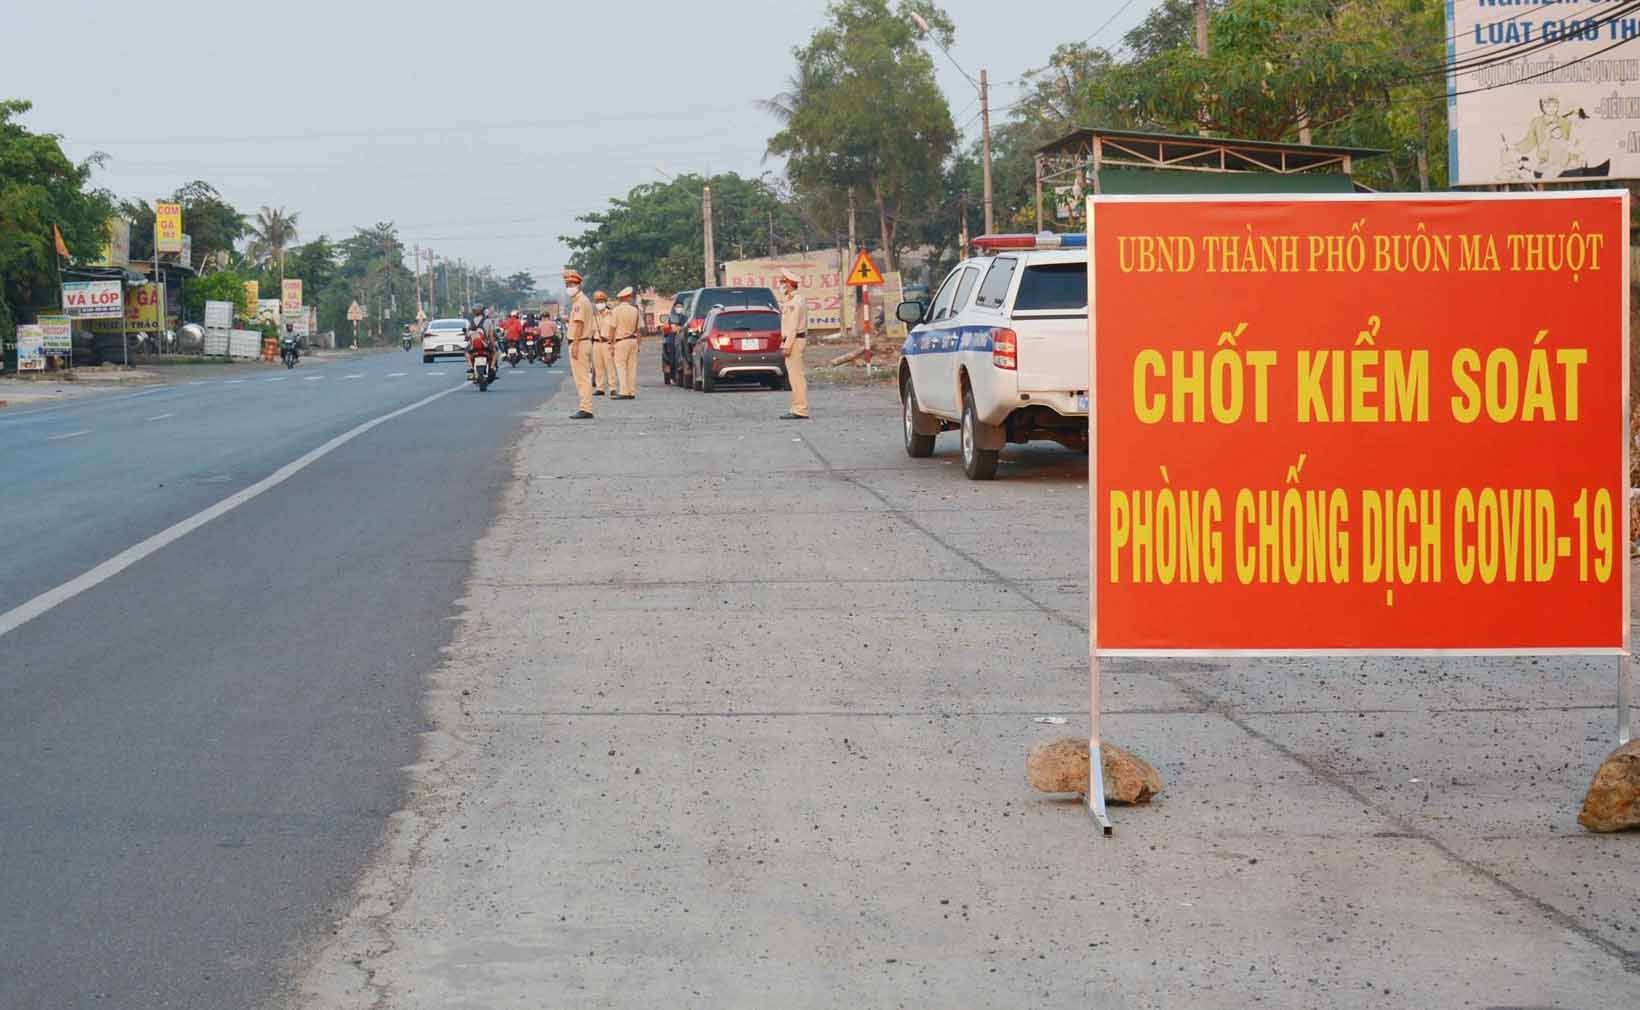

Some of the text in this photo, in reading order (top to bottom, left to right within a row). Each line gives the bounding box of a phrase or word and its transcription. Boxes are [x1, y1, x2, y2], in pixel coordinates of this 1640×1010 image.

[1543, 19, 1599, 42] GIAO
[1608, 18, 1640, 40] TH
[1119, 218, 1603, 281] UBND THÀNH PHỐ BUÔN MA THUỘT
[91, 288, 119, 305] LỐP
[1133, 315, 1588, 424] CHỐT KIỂM SOÁT
[1110, 454, 1613, 606] PHÒNG CHỐNG DỊCH COVID-19
